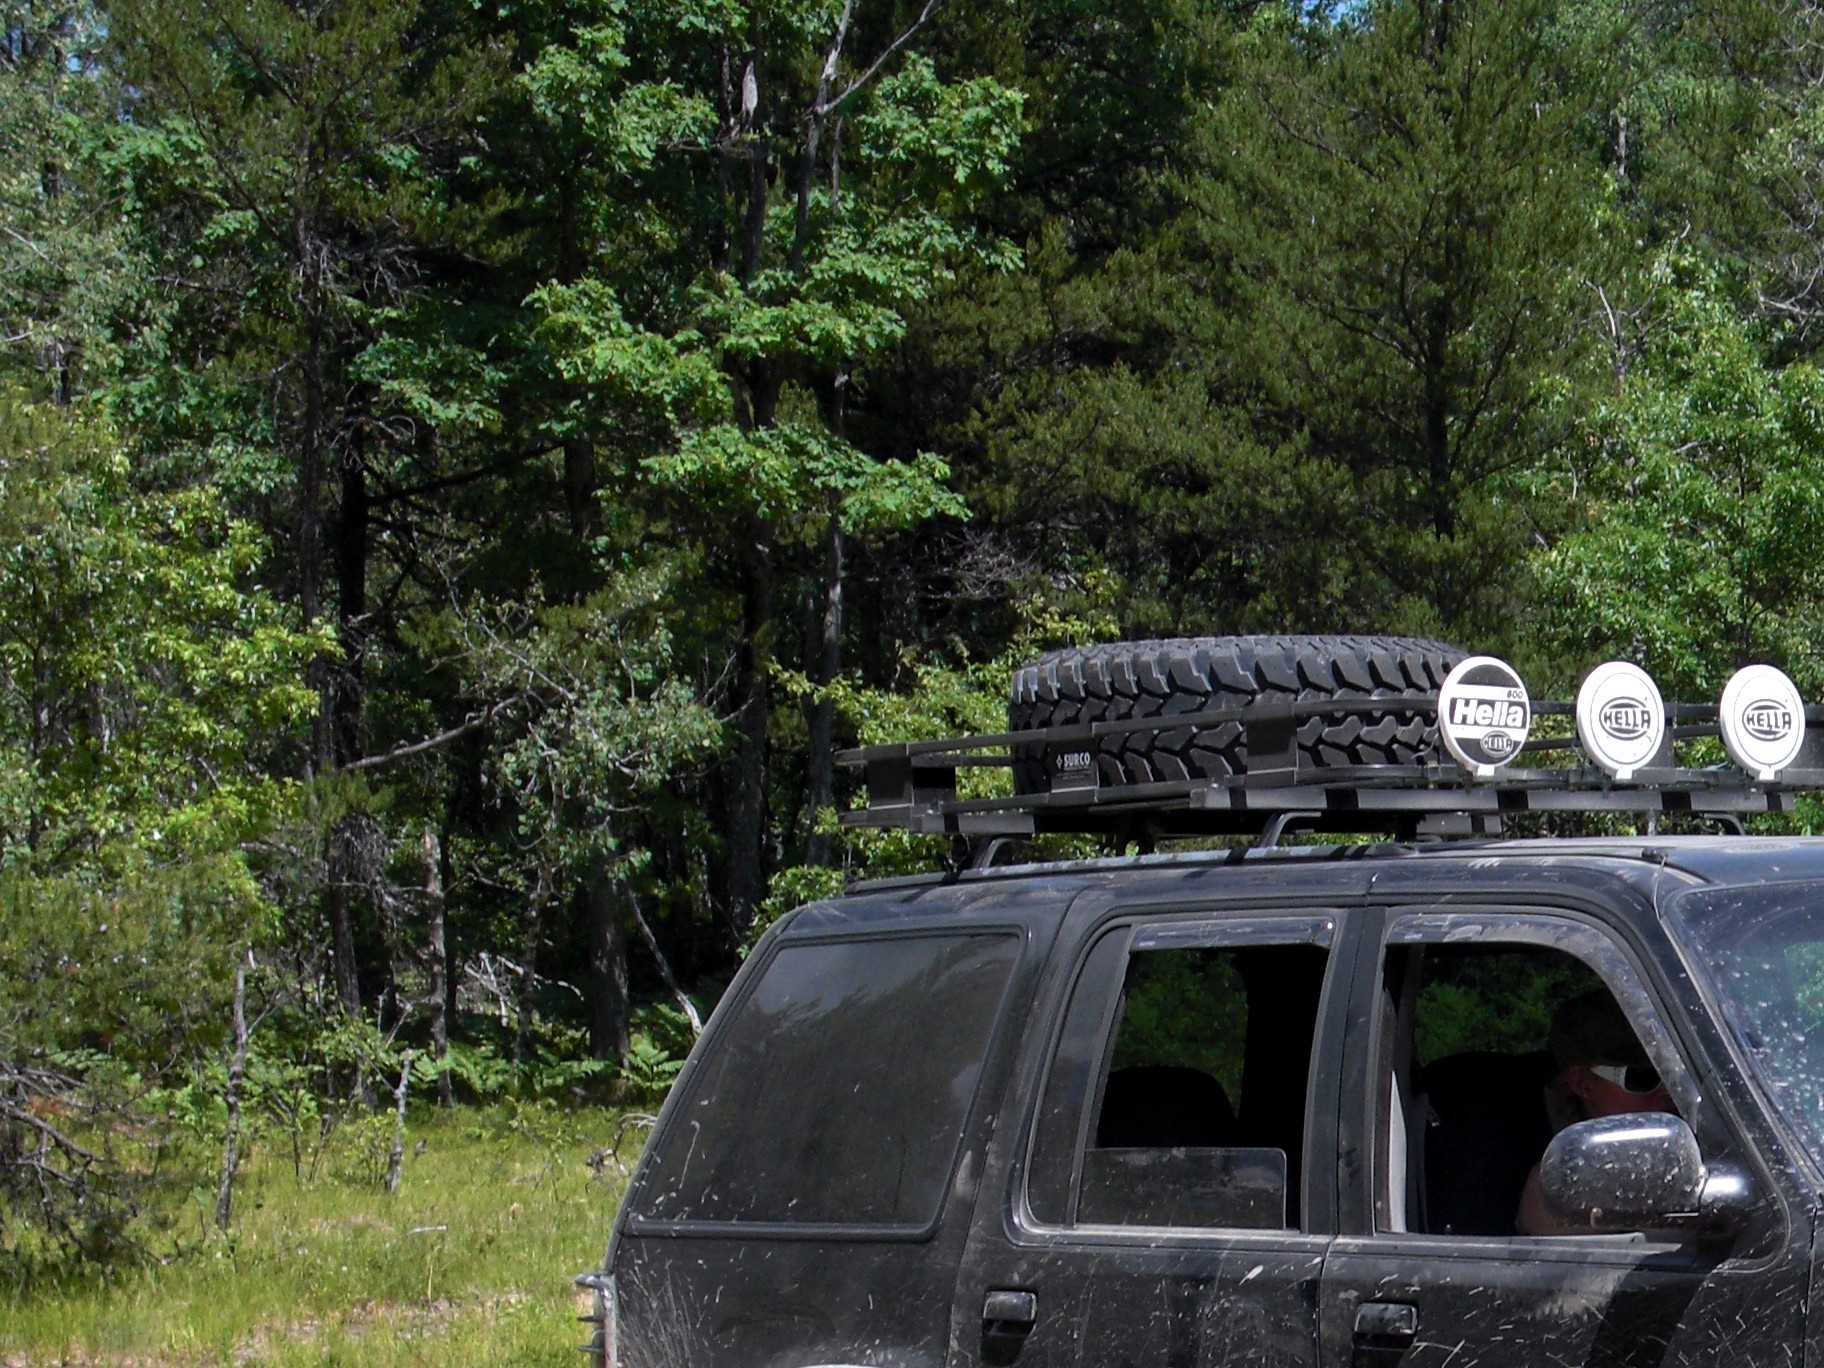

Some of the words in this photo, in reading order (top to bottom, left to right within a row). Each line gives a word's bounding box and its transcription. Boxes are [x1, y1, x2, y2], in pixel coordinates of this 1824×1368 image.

[1453, 698, 1524, 728] Hella
[1603, 708, 1651, 730] HELLA
[1746, 711, 1792, 731] HELLA
